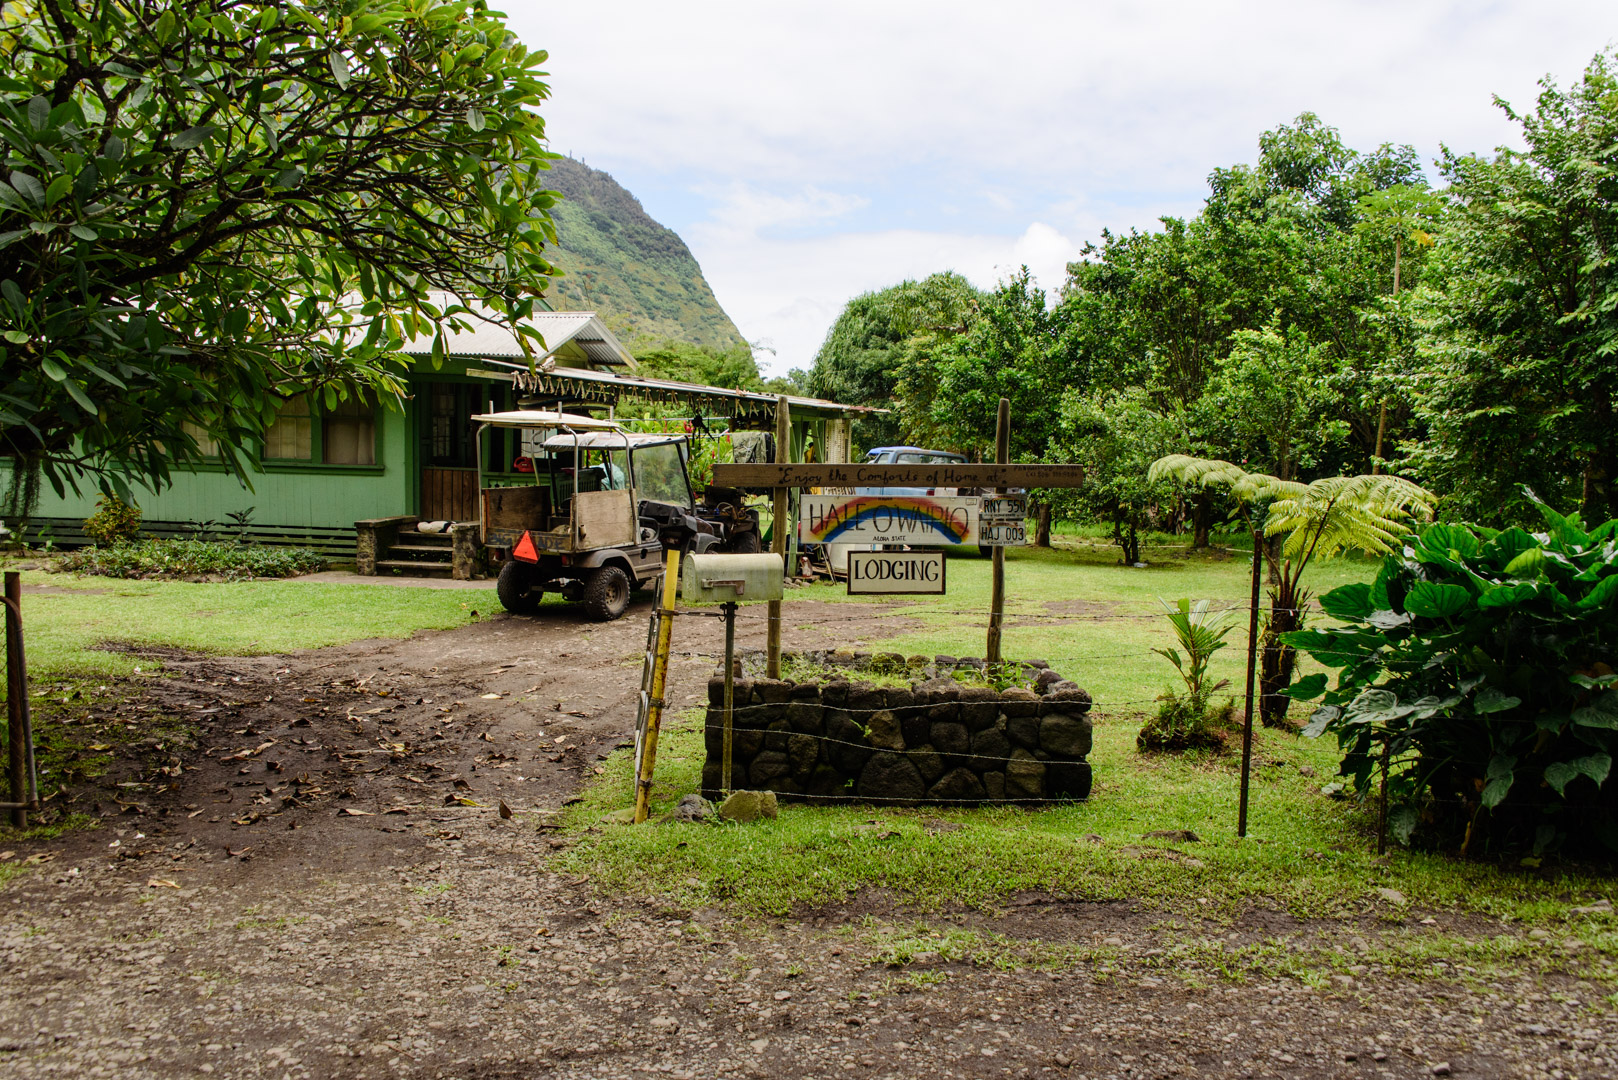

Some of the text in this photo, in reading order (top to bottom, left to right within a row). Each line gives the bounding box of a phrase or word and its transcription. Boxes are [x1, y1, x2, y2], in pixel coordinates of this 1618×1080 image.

[782, 467, 822, 485] Enjoy
[828, 468, 847, 481] the
[857, 467, 918, 484] Comforts
[925, 469, 938, 485] of
[943, 468, 979, 483] Home
[984, 499, 1002, 513] RNY
[1007, 499, 1026, 513] 550
[809, 502, 866, 532] HALE
[981, 526, 1024, 541] HAJ 003
[854, 559, 939, 582] LODGING
